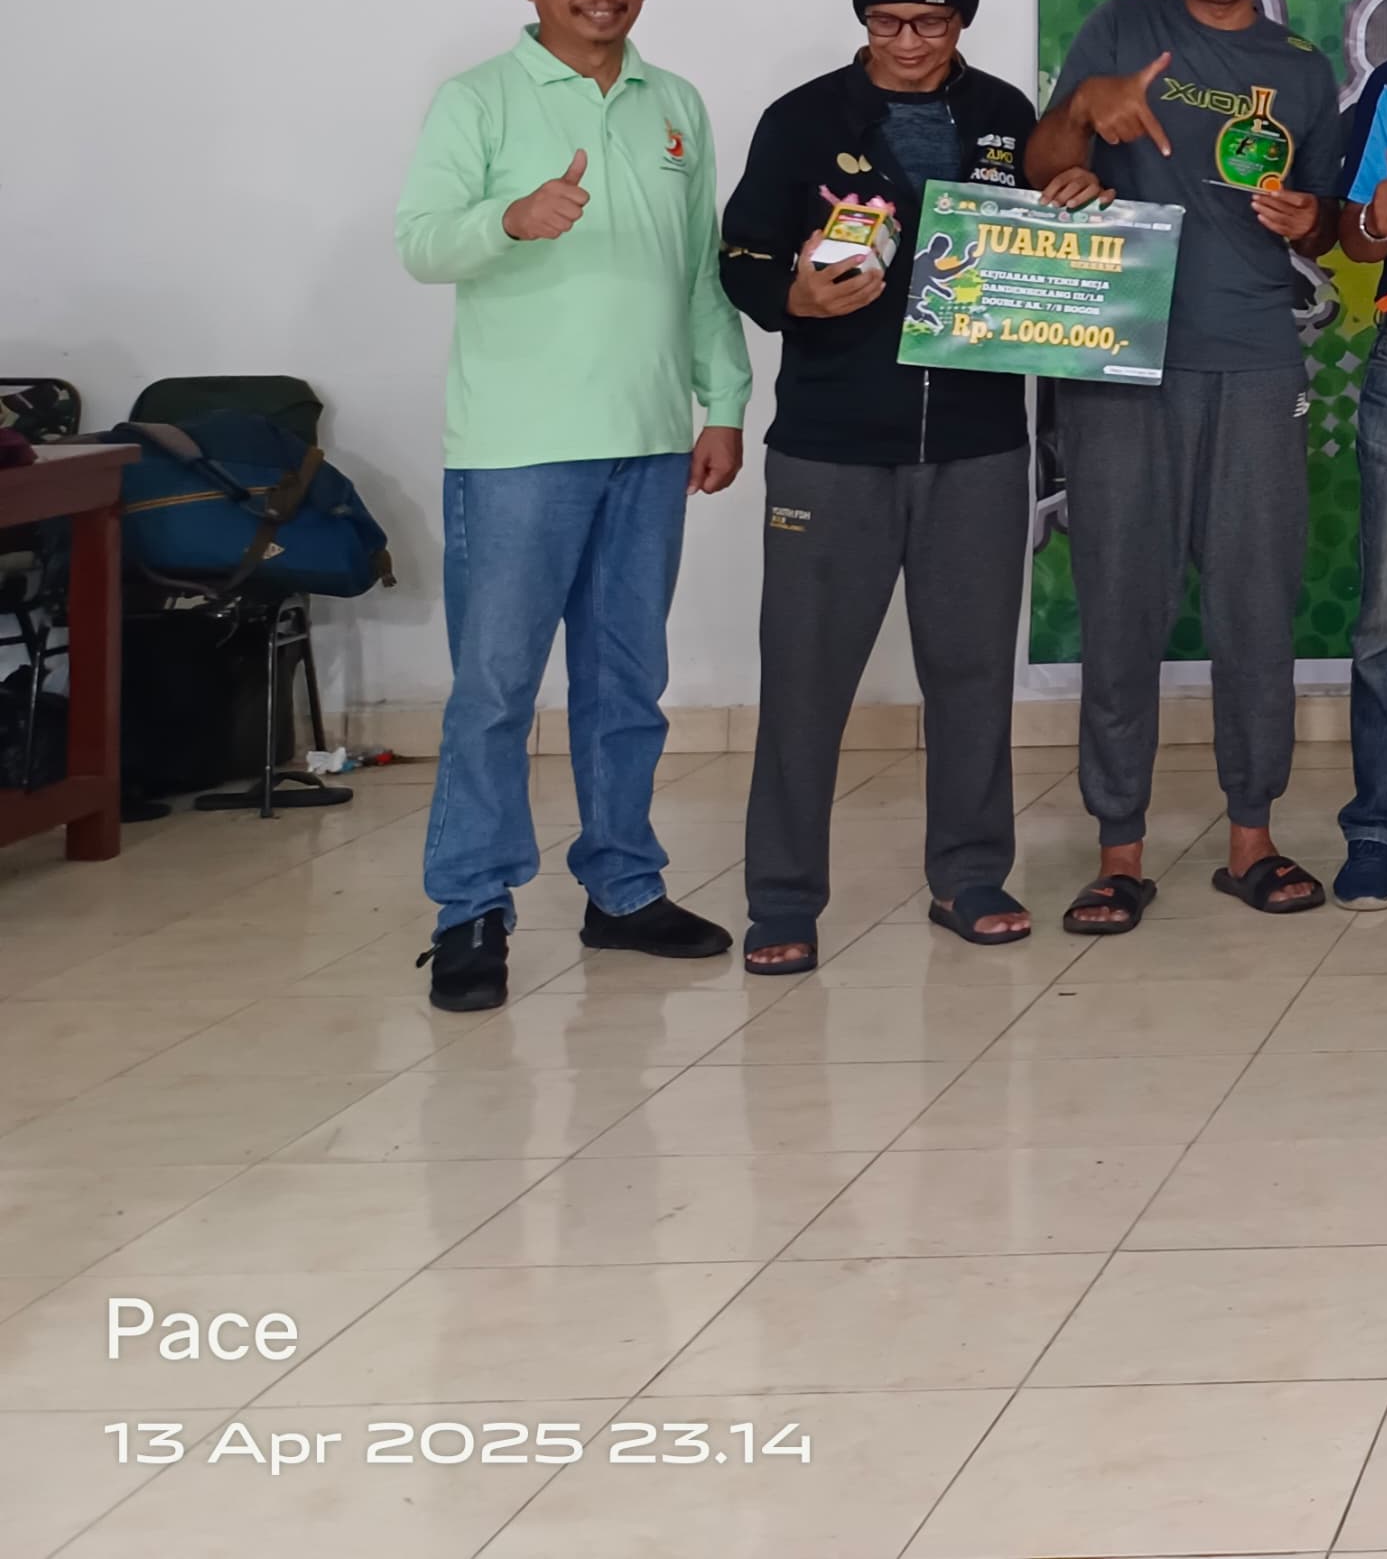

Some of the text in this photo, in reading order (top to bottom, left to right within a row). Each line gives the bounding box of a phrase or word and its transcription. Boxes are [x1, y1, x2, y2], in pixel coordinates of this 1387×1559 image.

[972, 223, 1125, 265] JUARA III
[952, 313, 1130, 355] Rp. 1.000.000,-
